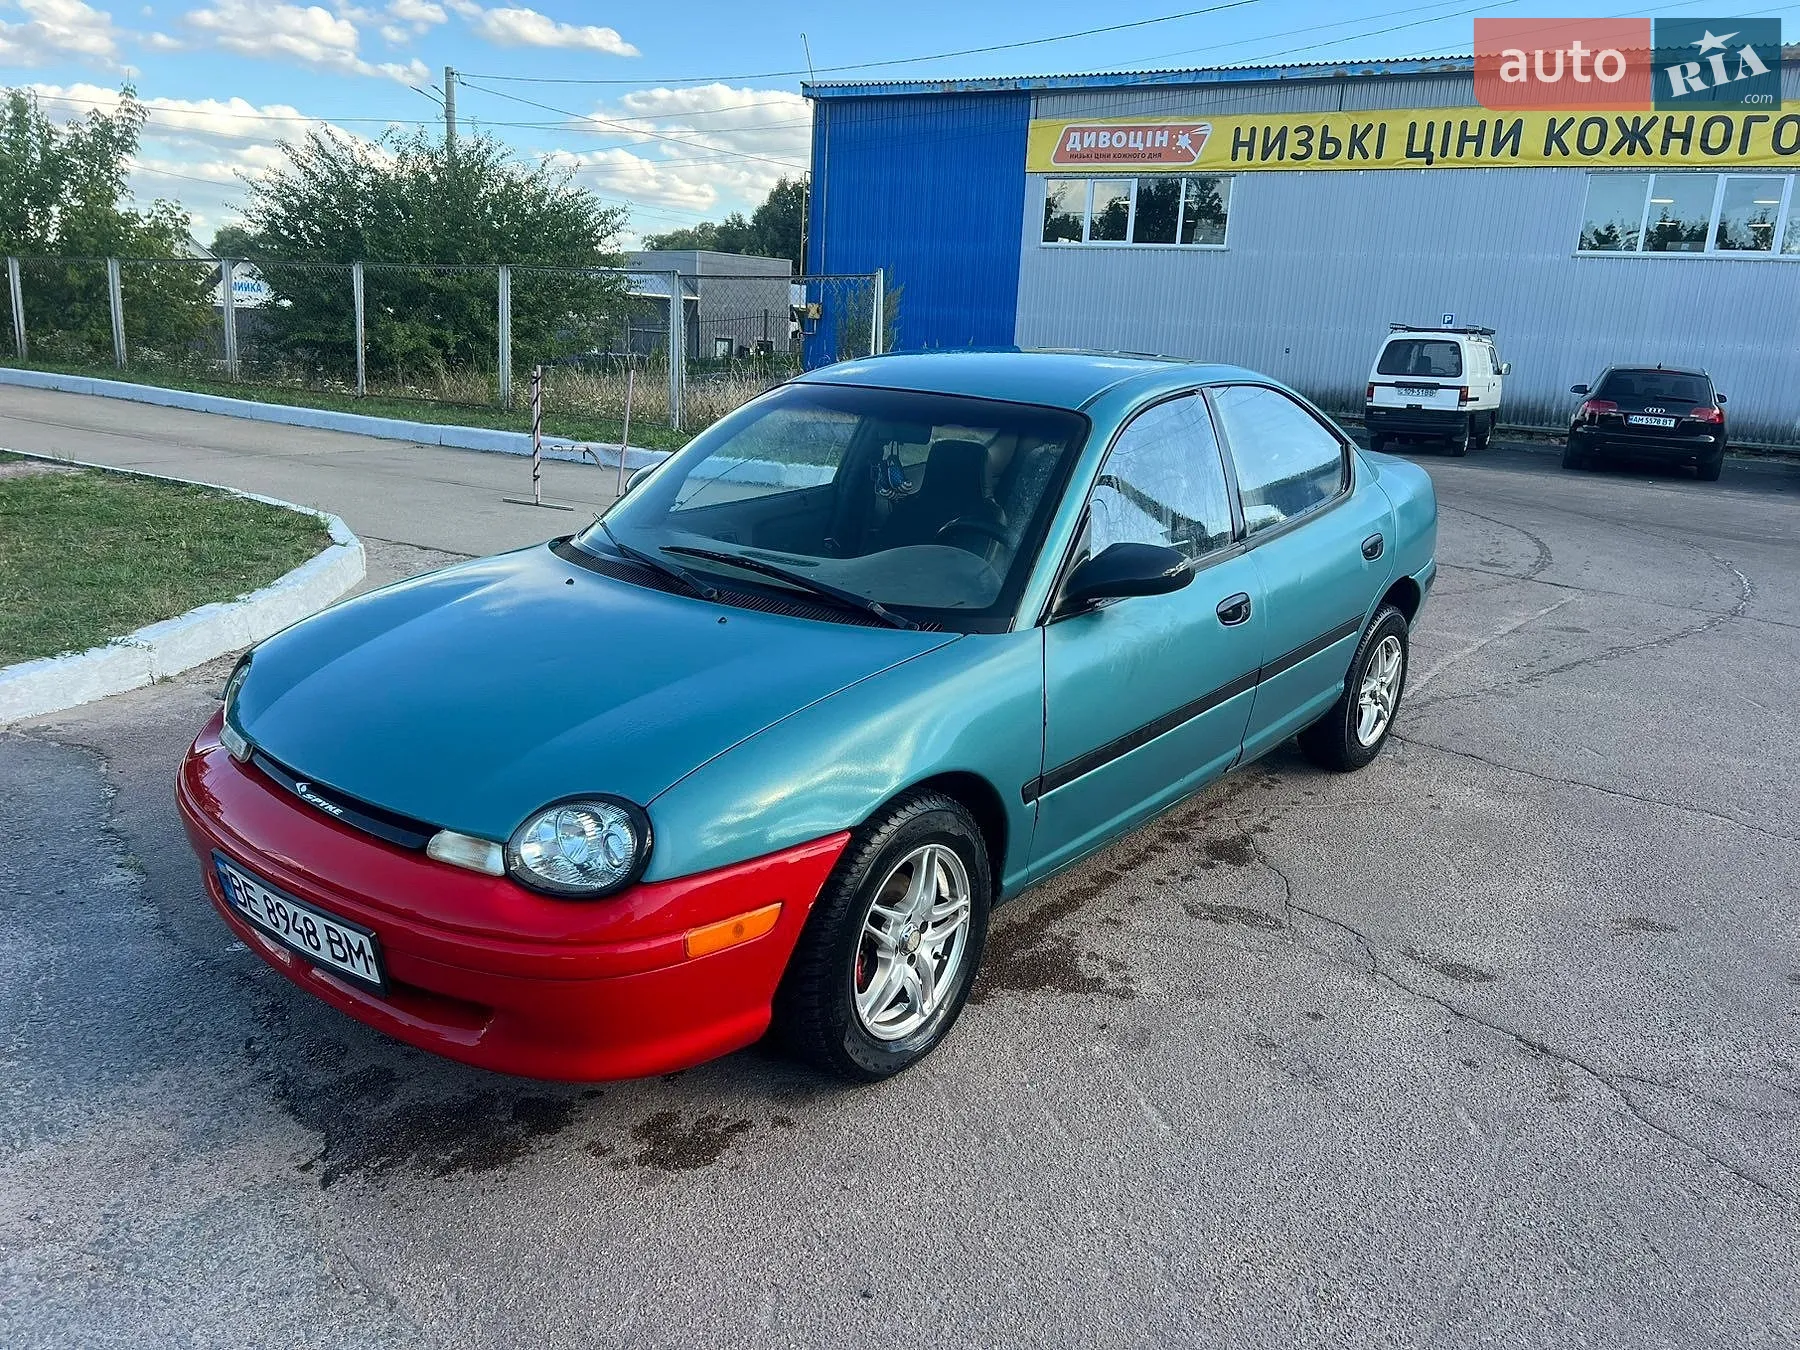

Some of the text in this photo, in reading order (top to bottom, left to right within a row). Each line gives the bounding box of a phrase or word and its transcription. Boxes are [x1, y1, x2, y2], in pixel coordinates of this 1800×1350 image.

[1066, 130, 1169, 152] ДИВОЦІН
[1069, 152, 1093, 160] НИЗЬКІ
[1094, 152, 1111, 160] ЦІНИ
[1147, 152, 1162, 160] ДНЯ
[1231, 115, 1800, 165] НИЗЬКІ ЦІНИ КОЖНОГО
[232, 874, 371, 975] BE 8948 BM
